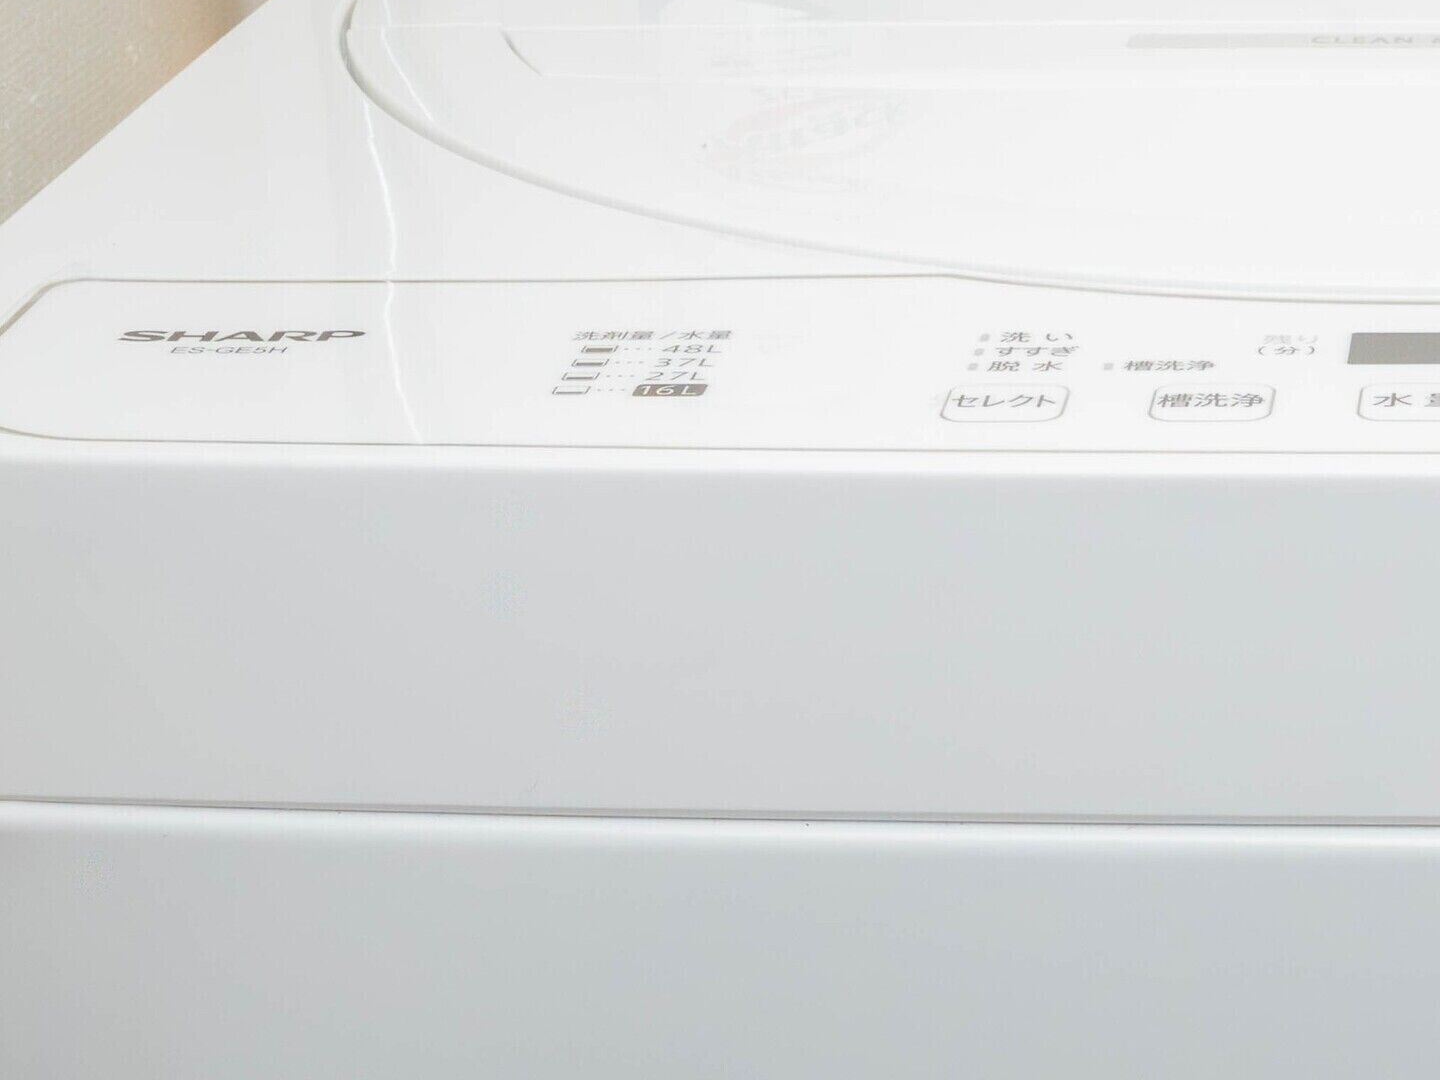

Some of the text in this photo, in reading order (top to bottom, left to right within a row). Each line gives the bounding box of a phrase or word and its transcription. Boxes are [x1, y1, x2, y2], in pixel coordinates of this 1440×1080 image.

[1310, 35, 1414, 45] CLEAN
[117, 330, 366, 342] SHARP
[170, 346, 289, 354] ES-GE5H
[662, 344, 722, 354] 48L
[995, 345, 1080, 357] すすぎ
[655, 358, 715, 367] 37L
[1123, 359, 1215, 372] 槽洗浄
[645, 371, 705, 381] 27L
[639, 385, 700, 396] 16L
[952, 393, 1057, 409] セレクト
[1158, 393, 1267, 409] 槽洗浄
